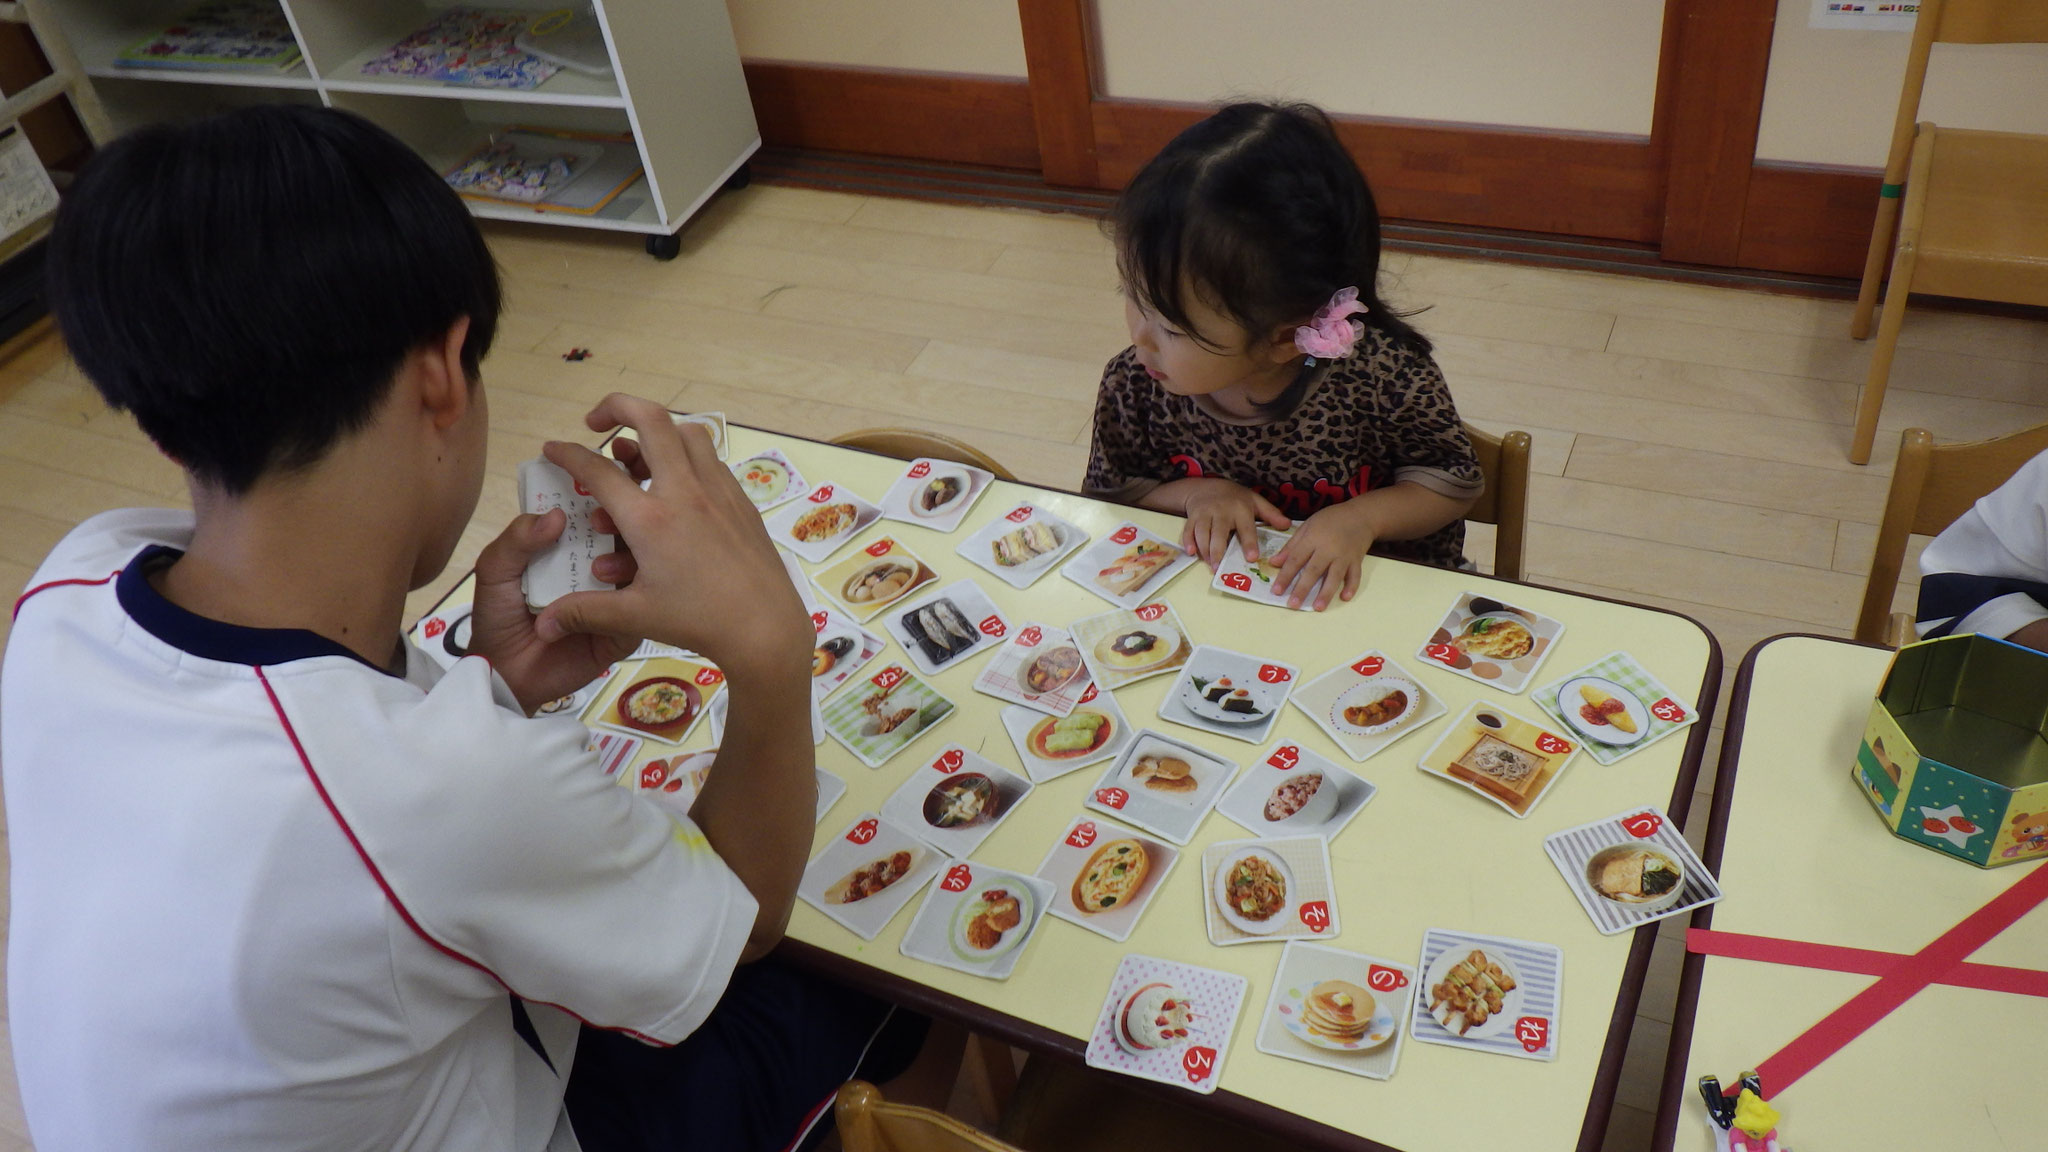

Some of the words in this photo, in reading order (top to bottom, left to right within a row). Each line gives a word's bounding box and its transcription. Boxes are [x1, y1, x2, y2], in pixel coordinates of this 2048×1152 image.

[1141, 606, 1158, 618] ゆ
[982, 617, 1001, 632] け
[1021, 632, 1039, 646] た
[1434, 646, 1450, 660] て
[697, 668, 714, 683] わ
[878, 671, 898, 686] ぬ
[1654, 703, 1675, 718] あ
[1543, 736, 1562, 751] な
[941, 757, 959, 772] ん
[1275, 753, 1295, 768] よ
[643, 769, 661, 783] る
[1106, 789, 1122, 804] き
[1631, 819, 1652, 831] つ
[854, 826, 873, 840] ち
[1071, 830, 1093, 846] れ
[948, 871, 965, 889] か
[1304, 905, 1325, 922] そ
[1372, 970, 1395, 986] の
[1521, 1020, 1544, 1040] ね
[1187, 1050, 1210, 1069] ろ
